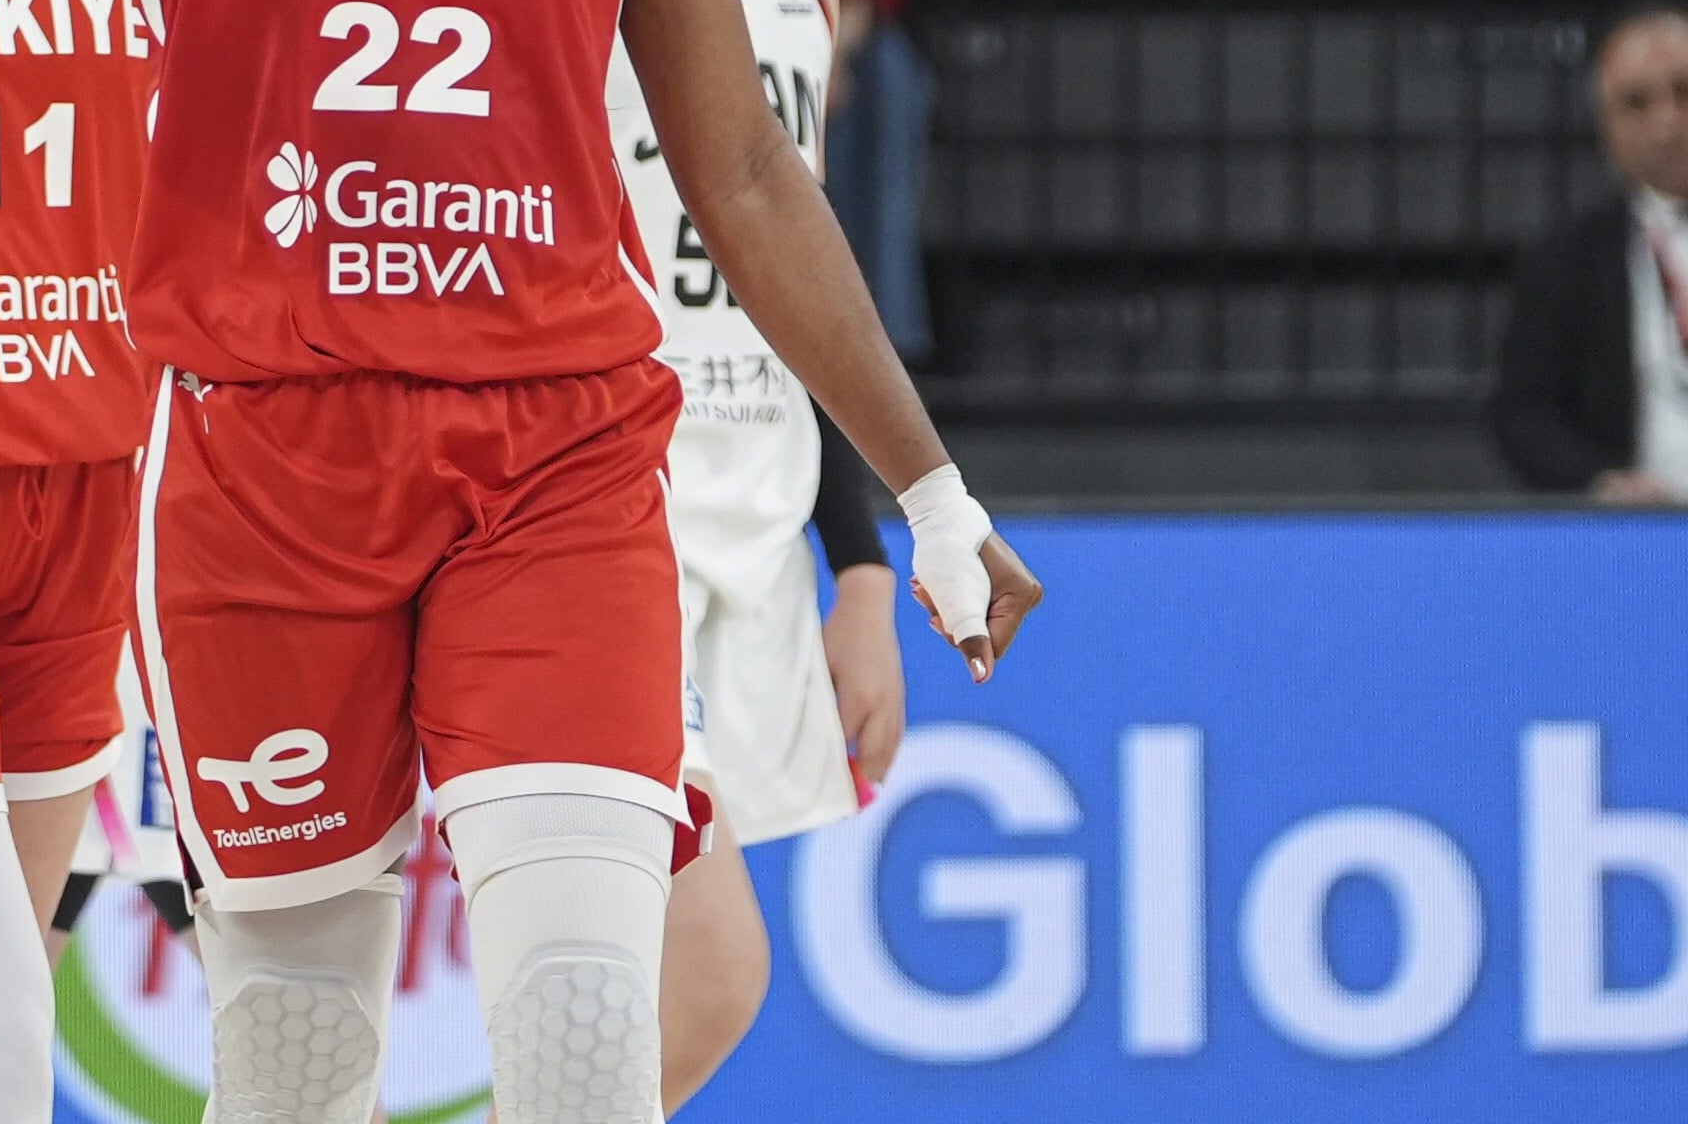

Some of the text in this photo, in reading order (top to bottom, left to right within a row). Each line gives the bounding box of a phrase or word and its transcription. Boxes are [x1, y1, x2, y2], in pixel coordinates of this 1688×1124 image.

[312, 1, 492, 117] 22
[324, 160, 555, 246] Garanti
[328, 242, 505, 297] BBVA
[674, 213, 740, 306] 5
[212, 811, 348, 849] TotalEnergies
[789, 721, 1688, 1062] Glob
